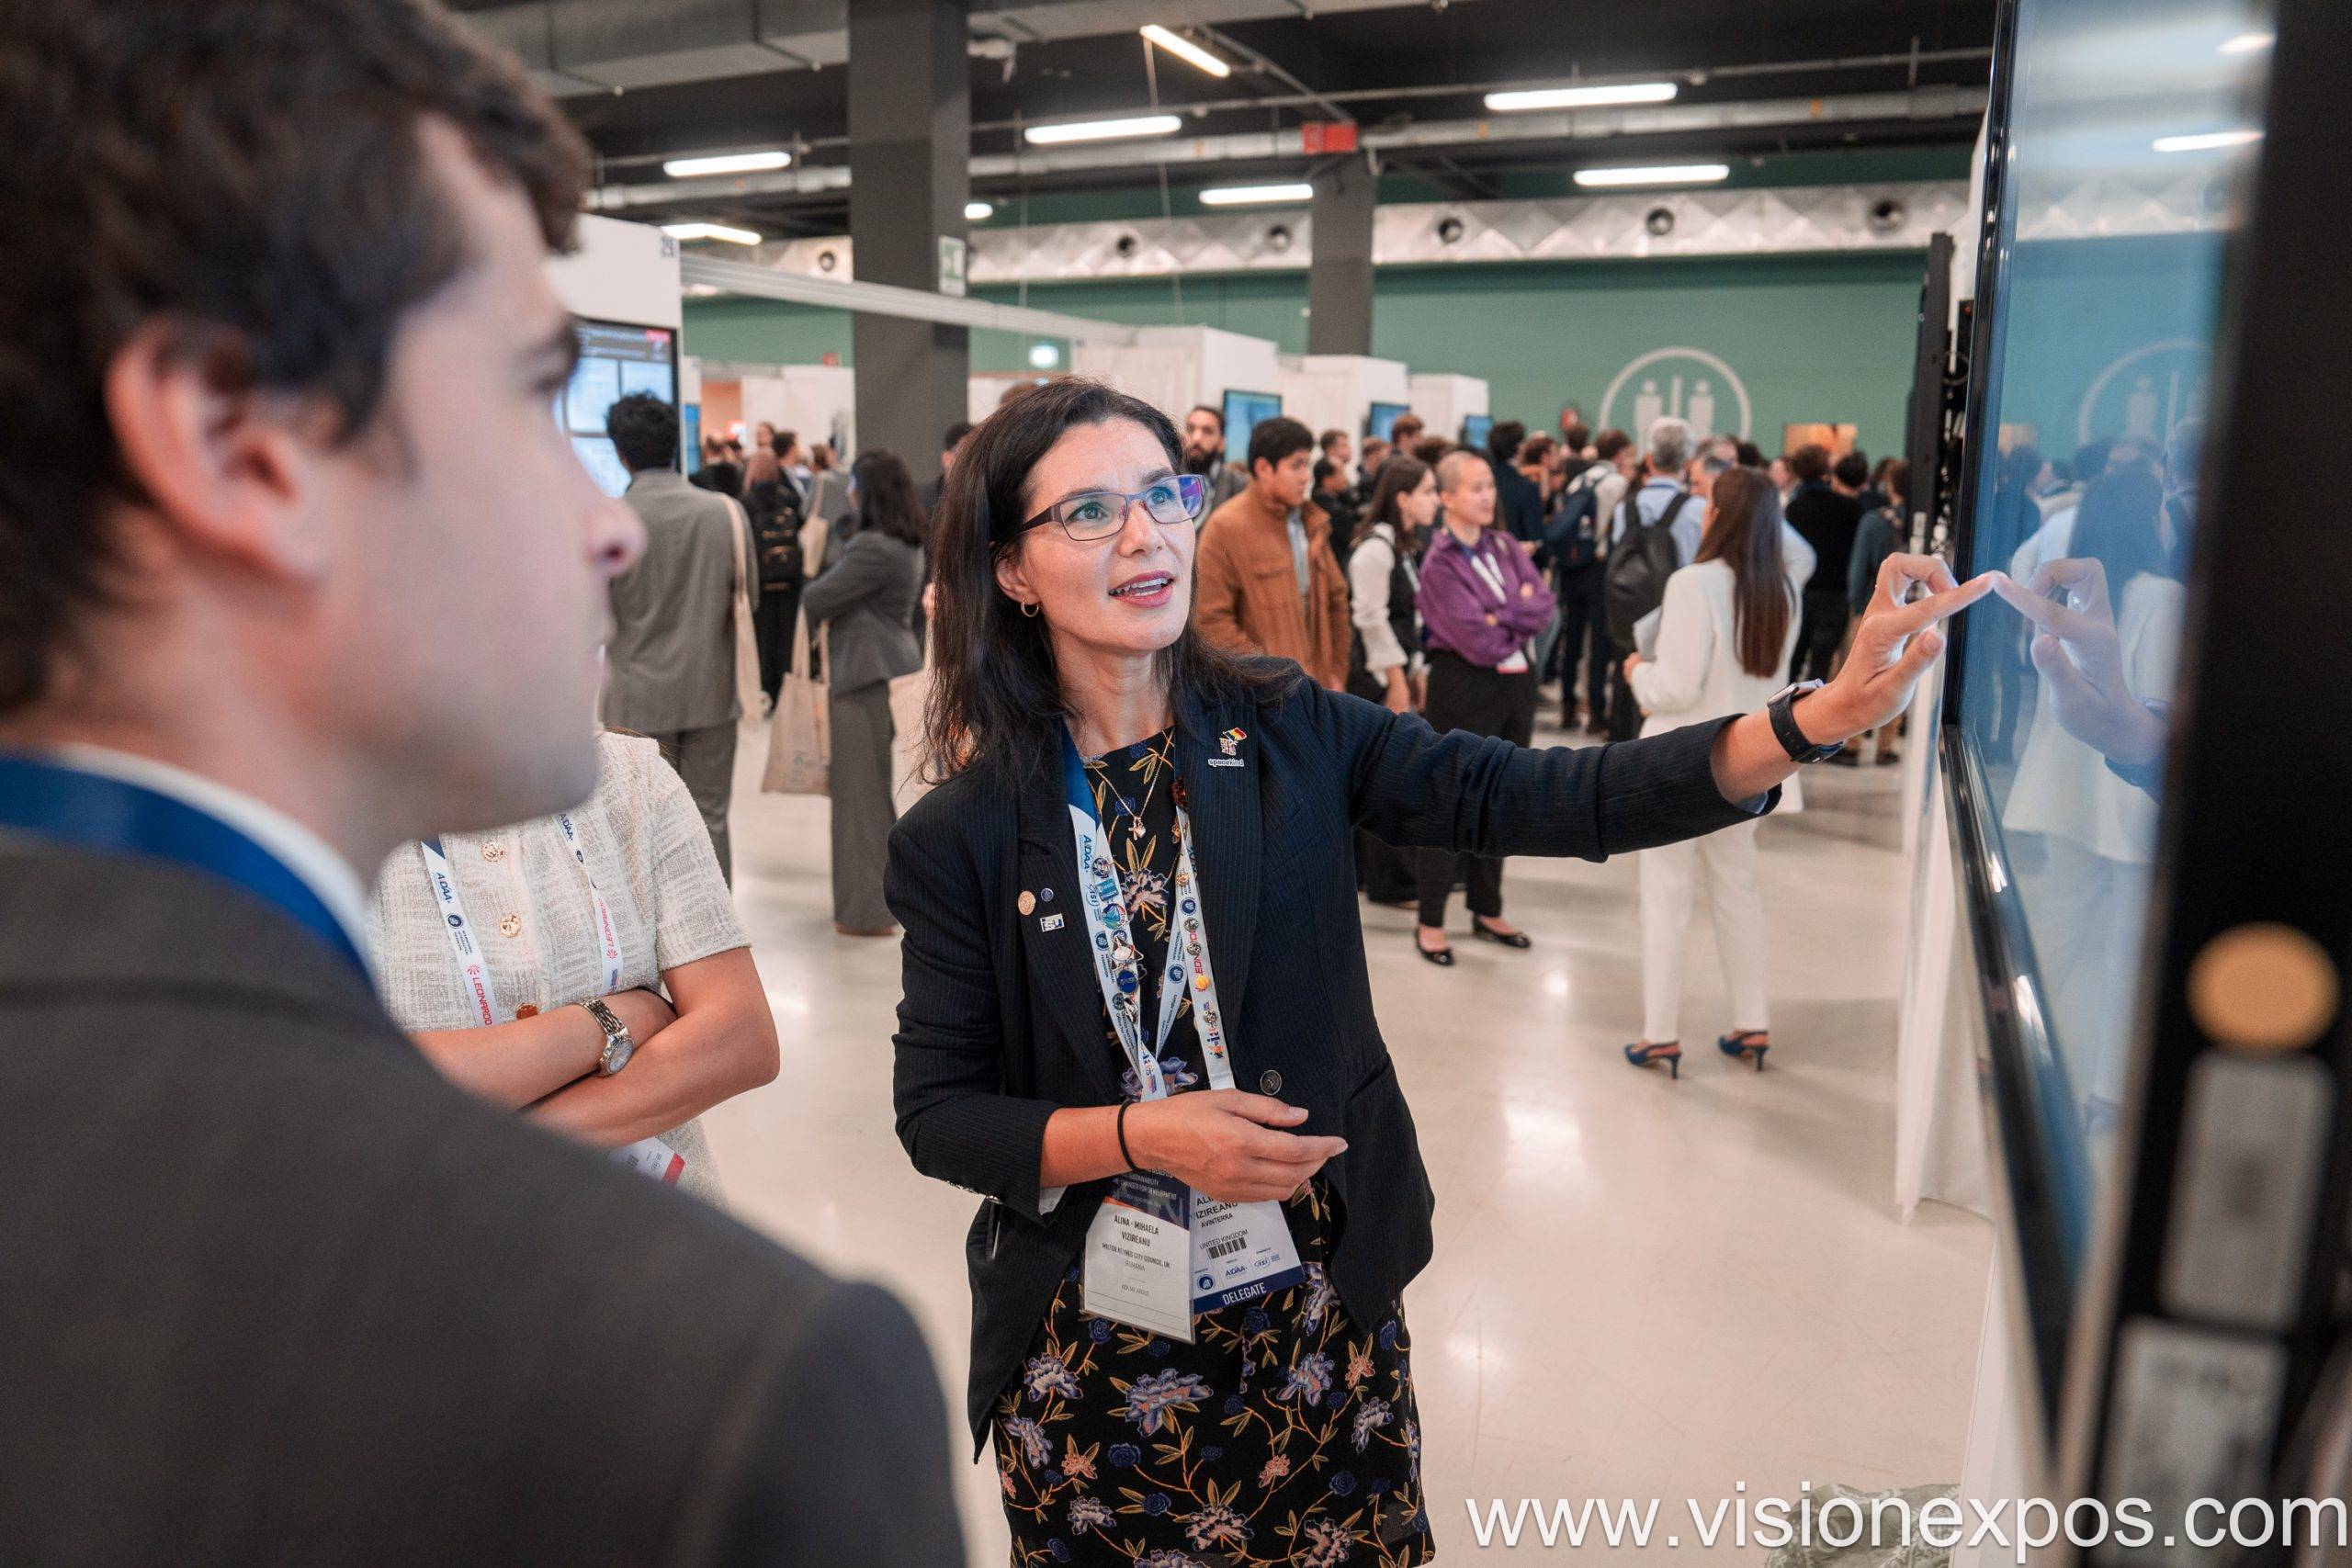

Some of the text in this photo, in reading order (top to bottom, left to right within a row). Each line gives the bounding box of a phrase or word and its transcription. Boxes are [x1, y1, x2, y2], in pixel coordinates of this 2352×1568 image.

[1208, 759, 1244, 767] spacekind
[472, 977, 492, 1025] LEONARDO
[1193, 1202, 1238, 1220] IZIREANU
[1114, 1214, 1130, 1226] ALINA
[1134, 1221, 1159, 1235] MIHAELA
[1201, 1213, 1233, 1228] AVINTERRA
[1121, 1231, 1150, 1247] VIZIREANU
[1199, 1229, 1249, 1249] UNITED KINGDOM
[1134, 1252, 1144, 1261] CITY
[1222, 1282, 1267, 1304] DELEGATE
